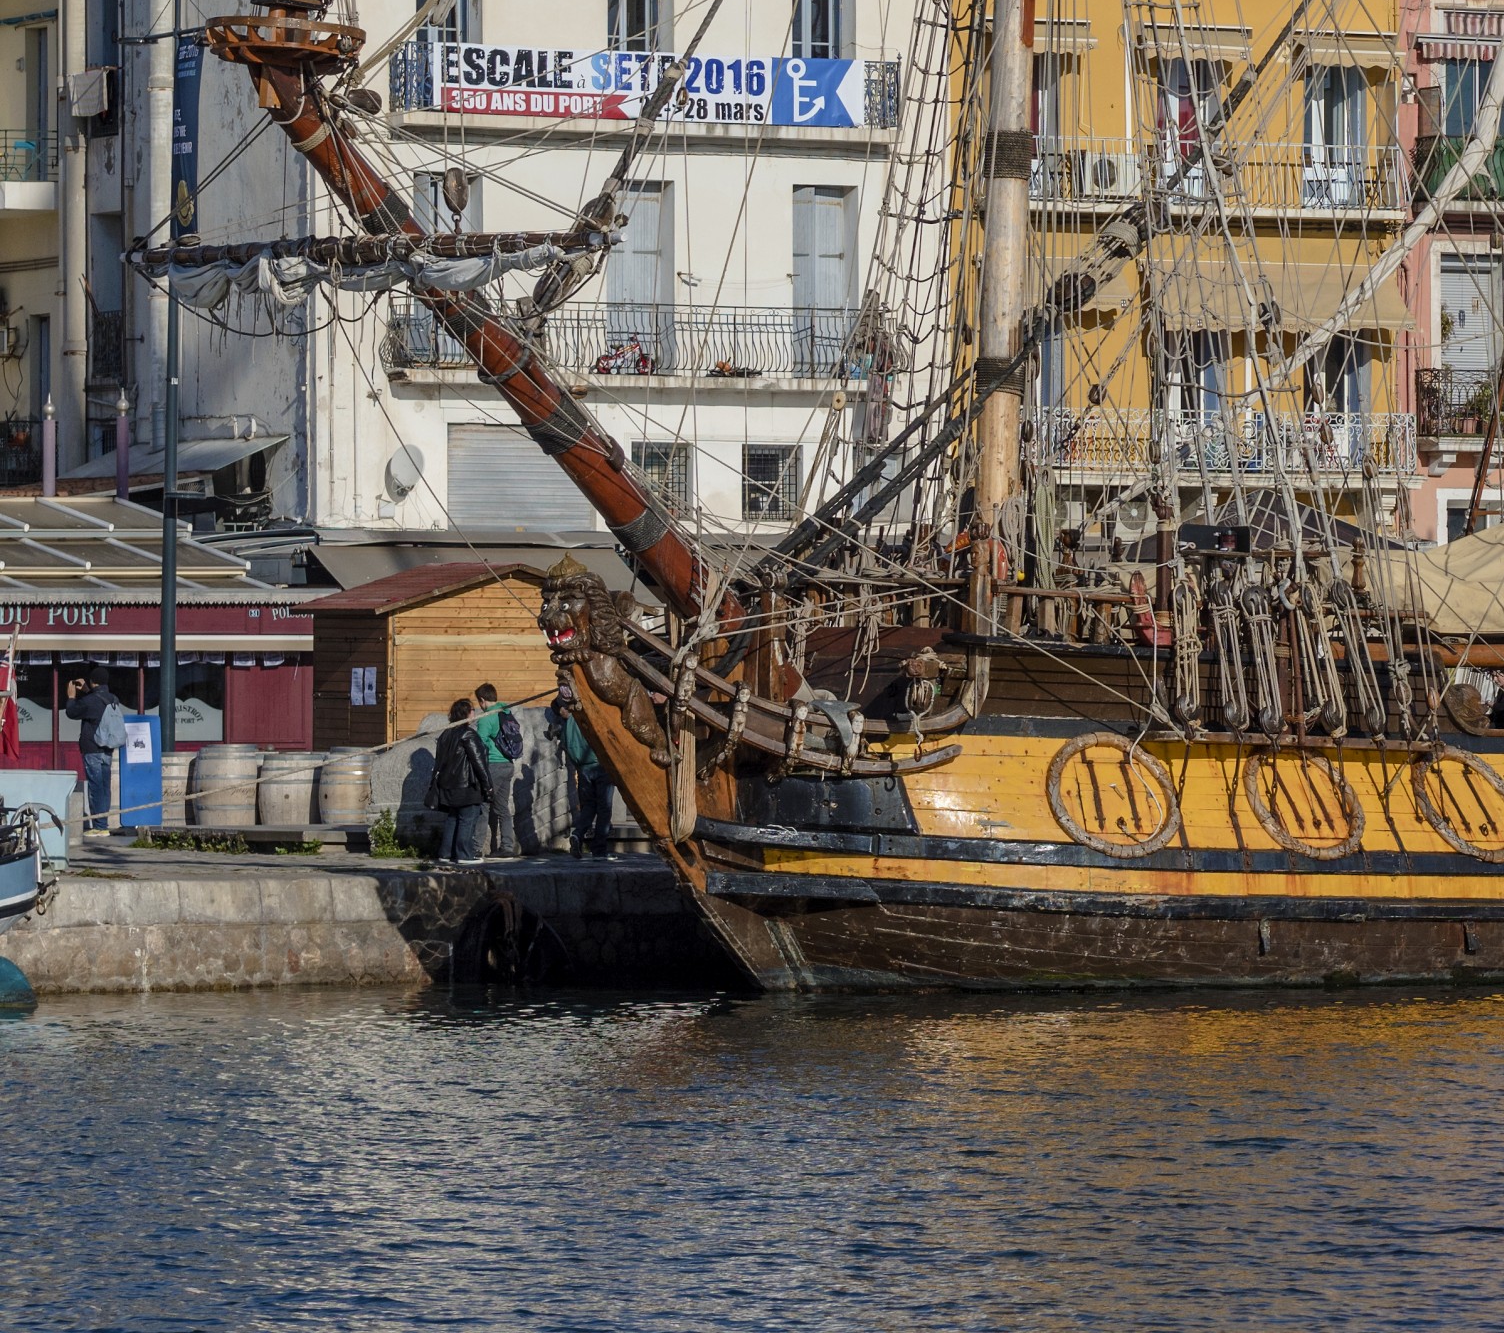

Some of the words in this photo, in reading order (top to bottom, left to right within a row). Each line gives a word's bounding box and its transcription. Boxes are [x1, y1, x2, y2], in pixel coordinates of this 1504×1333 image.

[441, 45, 574, 89] ESCALE
[576, 73, 587, 89] à
[685, 56, 766, 97] 2016
[451, 90, 488, 110] 350
[490, 92, 527, 113] ANS
[530, 94, 556, 113] DU
[558, 95, 605, 115] PORT
[684, 97, 708, 120] 28
[714, 100, 764, 122] mars
[46, 603, 112, 626] PORT
